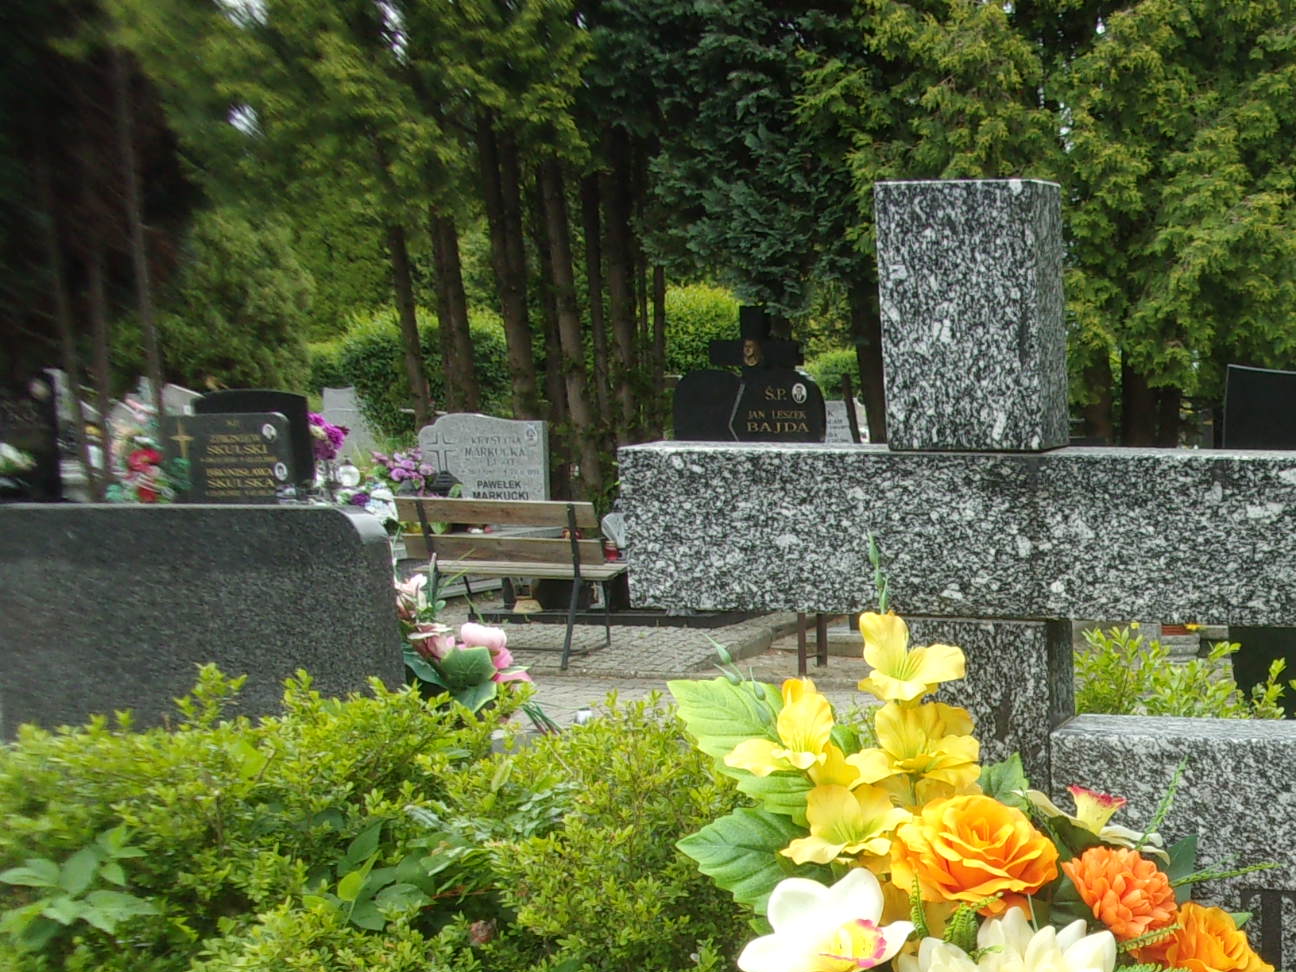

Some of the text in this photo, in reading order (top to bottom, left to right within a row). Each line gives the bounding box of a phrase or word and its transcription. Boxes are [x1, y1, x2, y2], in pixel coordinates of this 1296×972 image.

[748, 410, 765, 420] JAN
[747, 421, 809, 434] BAJDA
[472, 490, 529, 500] MARKUCKI
